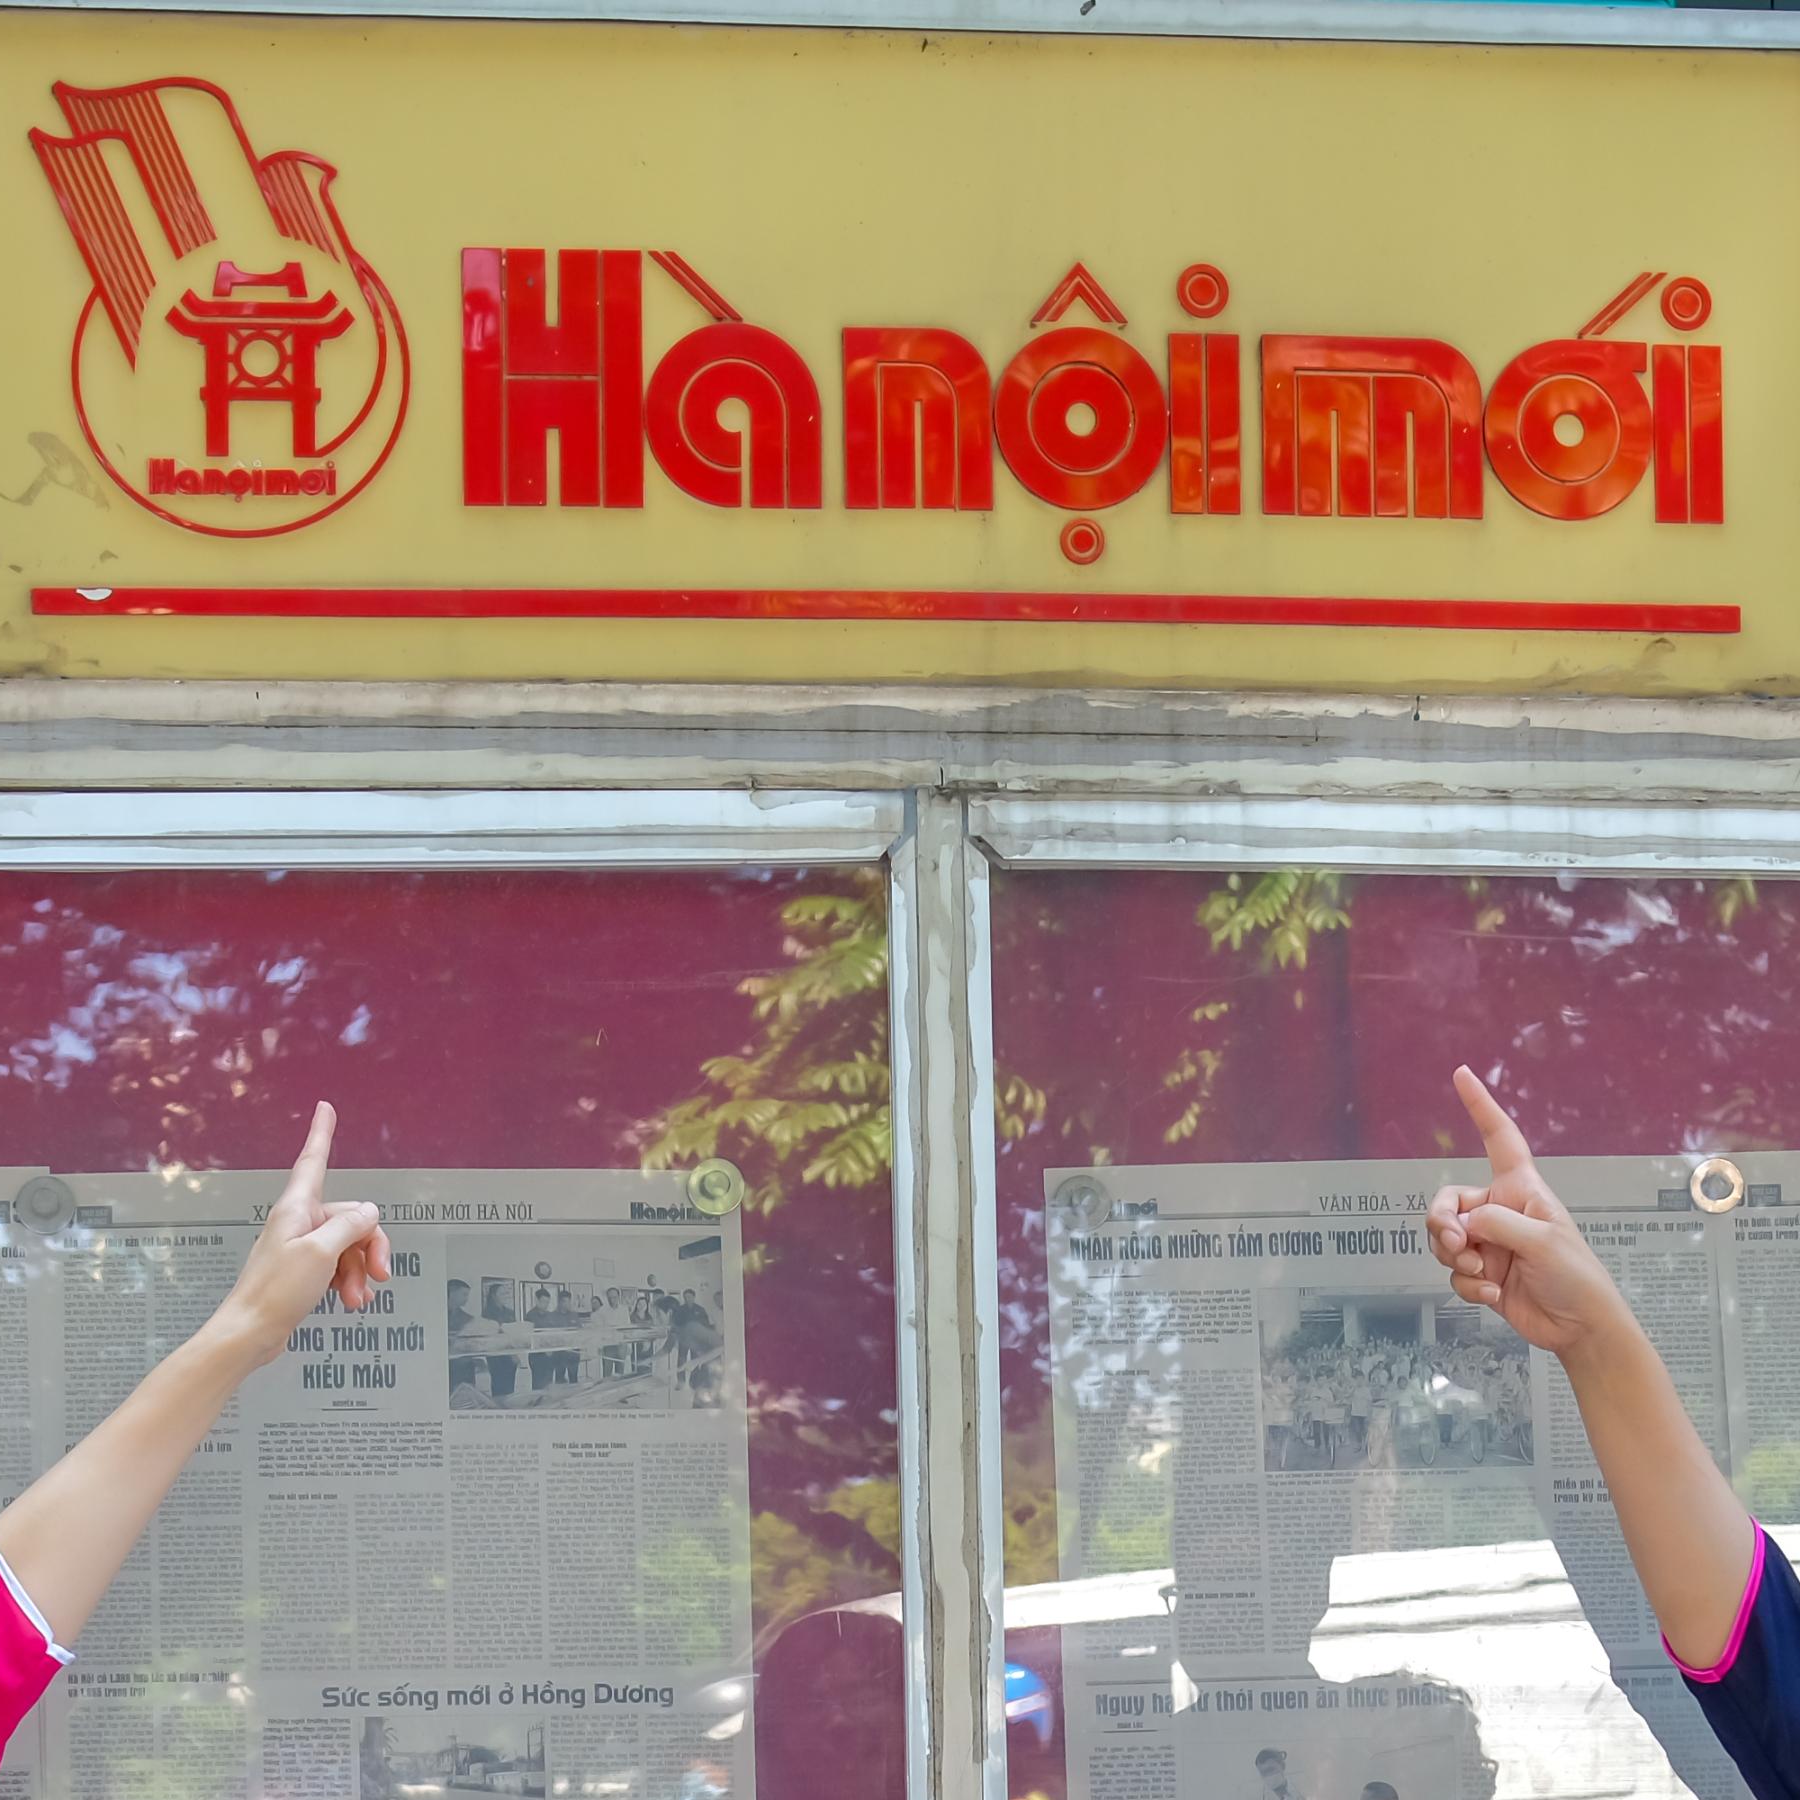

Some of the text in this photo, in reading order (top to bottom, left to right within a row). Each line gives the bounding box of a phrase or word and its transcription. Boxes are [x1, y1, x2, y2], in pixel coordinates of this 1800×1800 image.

[459, 246, 1725, 565] Hànộimới
[441, 1201, 470, 1220] MỚI
[506, 1201, 533, 1221] NỘI
[630, 1201, 720, 1221] Hànội
[1168, 1231, 1223, 1259] NHỮNG
[1228, 1224, 1264, 1257] TẤM
[1269, 1231, 1323, 1257] GƯƠNG
[1328, 1226, 1385, 1256] "NGƯỜI
[331, 1321, 424, 1351] THÔN MỚI
[303, 1351, 396, 1389] KIỂU MẪU
[322, 1680, 674, 1711] Sức sống mới ở Hồng Dương
[1096, 1687, 1388, 1717] Nguy thói quen ăn thực
